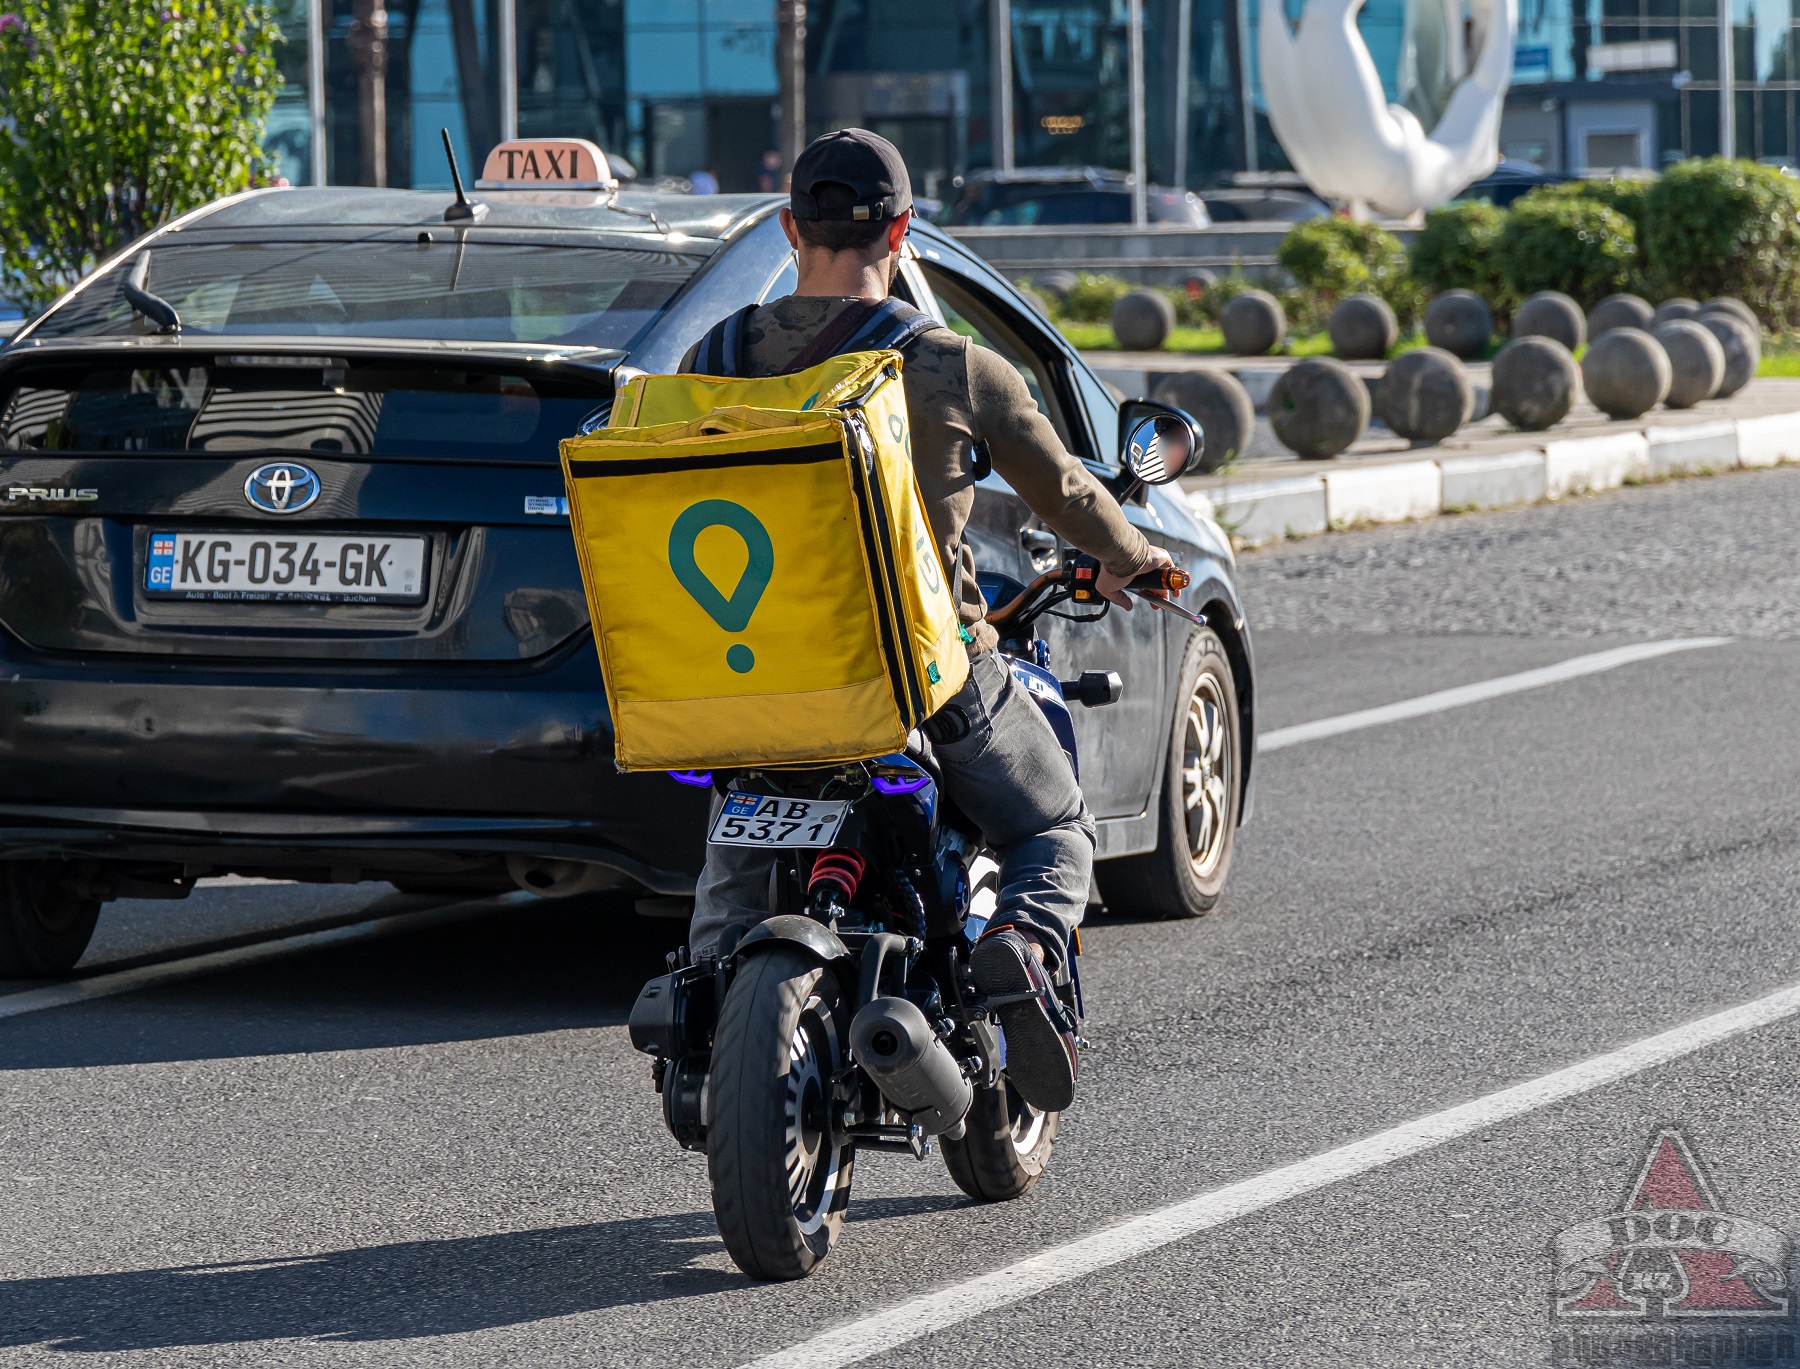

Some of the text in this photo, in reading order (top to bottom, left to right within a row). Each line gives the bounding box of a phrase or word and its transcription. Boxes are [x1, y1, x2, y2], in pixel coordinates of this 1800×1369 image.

[498, 148, 579, 180] TAXI
[8, 487, 98, 501] PRIUS
[180, 540, 390, 587] KG-034-GK
[150, 567, 172, 585] GE
[185, 591, 205, 600] Auto
[731, 805, 748, 815] GE
[755, 800, 811, 820] AB
[721, 818, 825, 842] 5371
